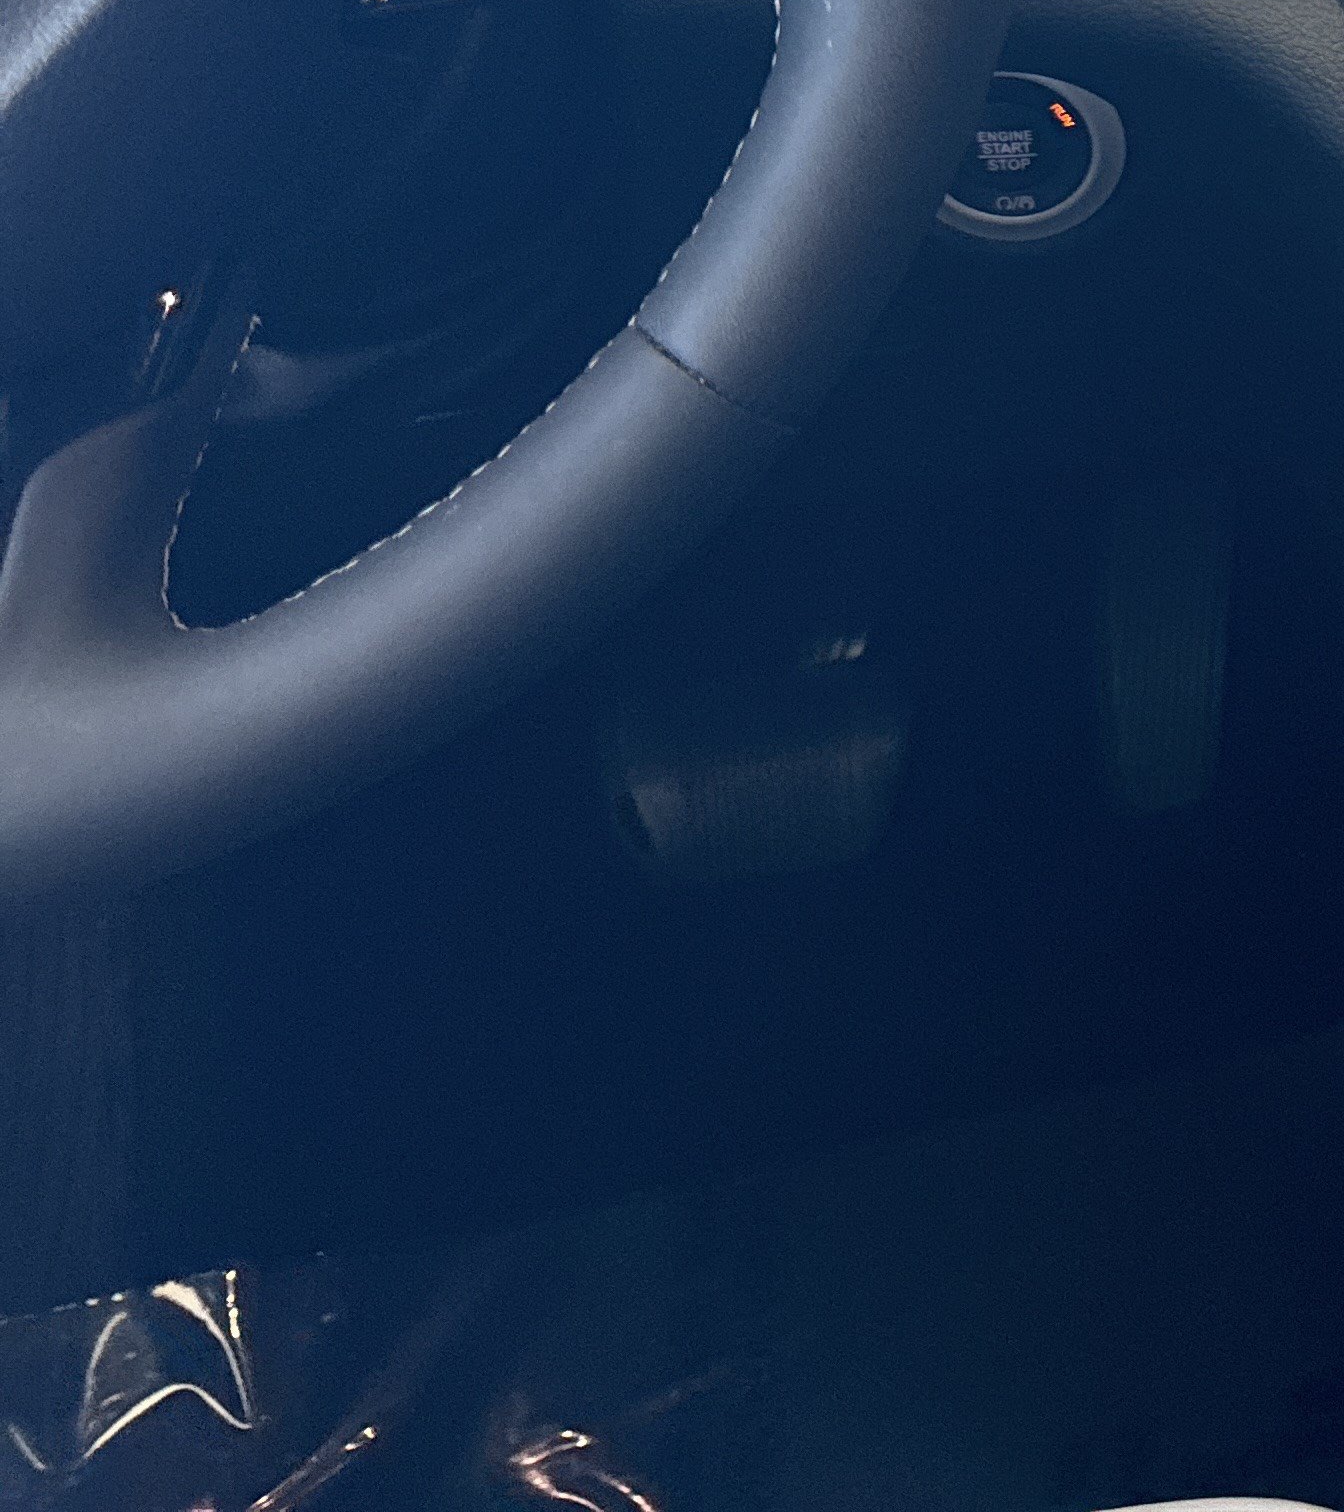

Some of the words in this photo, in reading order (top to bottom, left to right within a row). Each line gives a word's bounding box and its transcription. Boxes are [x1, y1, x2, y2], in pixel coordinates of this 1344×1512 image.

[976, 130, 1034, 142] ENGINE
[981, 142, 1032, 155] START
[987, 158, 1031, 172] STOP
